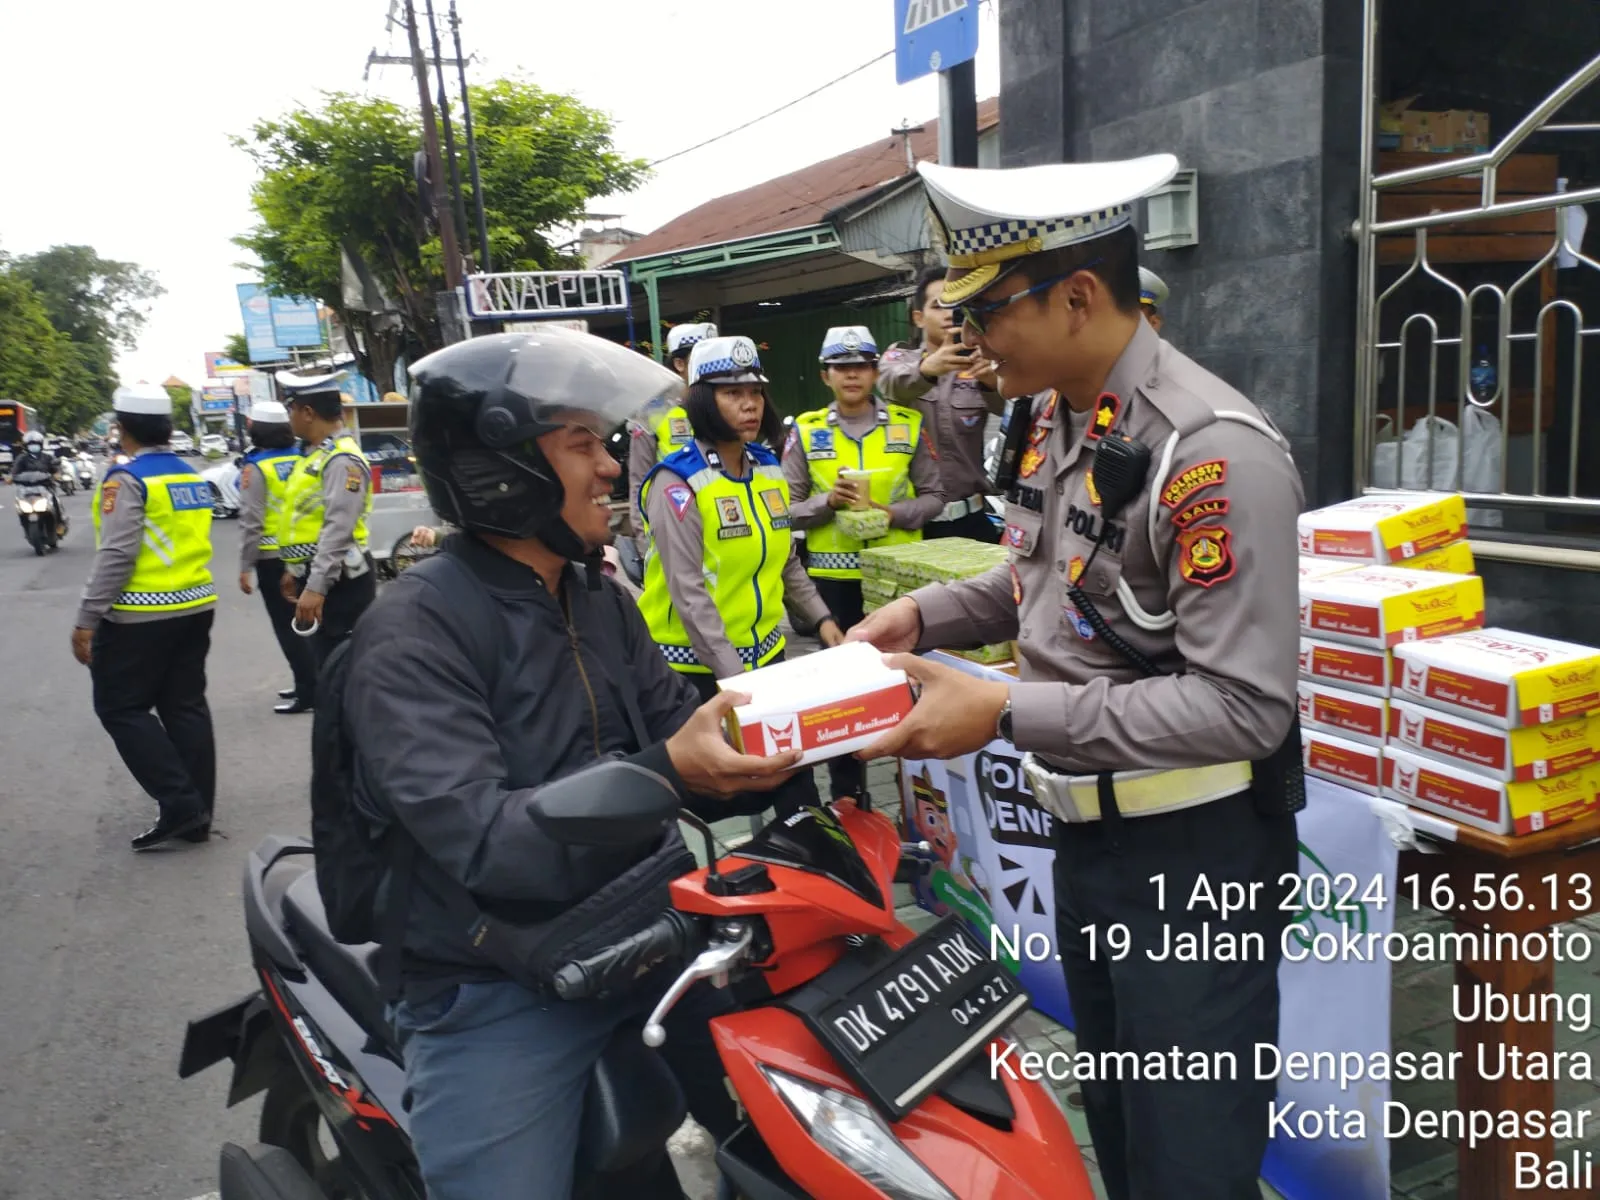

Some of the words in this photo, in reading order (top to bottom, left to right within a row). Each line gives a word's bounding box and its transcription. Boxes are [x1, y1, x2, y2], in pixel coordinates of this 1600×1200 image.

[475, 273, 624, 312] KNALPOT
[1165, 463, 1222, 502] POLRESTA
[1182, 502, 1219, 520] BALI
[816, 723, 849, 742] Selamat
[851, 711, 900, 734] Menikmati
[981, 755, 1033, 796] POL
[834, 1009, 886, 1052] DK
[876, 964, 941, 1021] 4791
[928, 933, 984, 985] ADK
